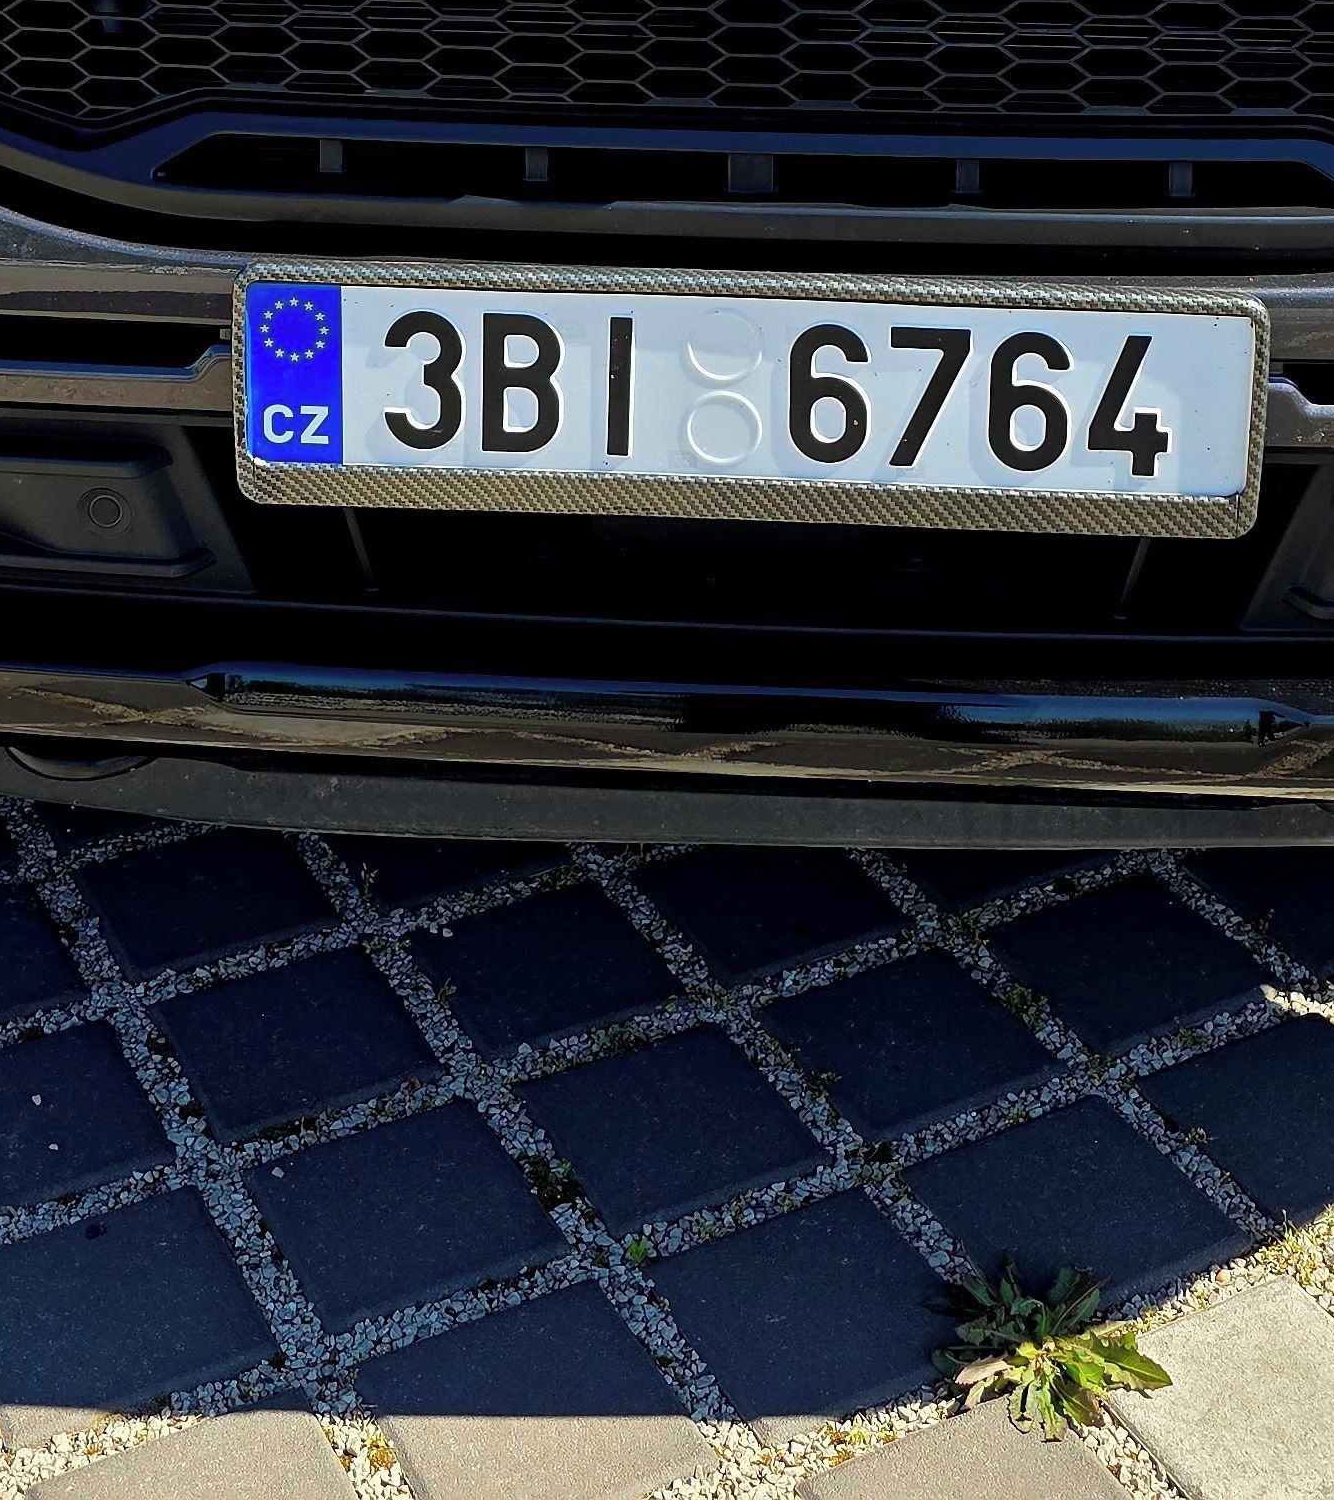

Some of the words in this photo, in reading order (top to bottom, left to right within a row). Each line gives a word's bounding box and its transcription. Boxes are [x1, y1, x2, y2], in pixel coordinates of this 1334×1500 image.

[263, 404, 330, 445] CZ
[384, 310, 633, 457] 3BI
[789, 323, 1169, 477] 6764
